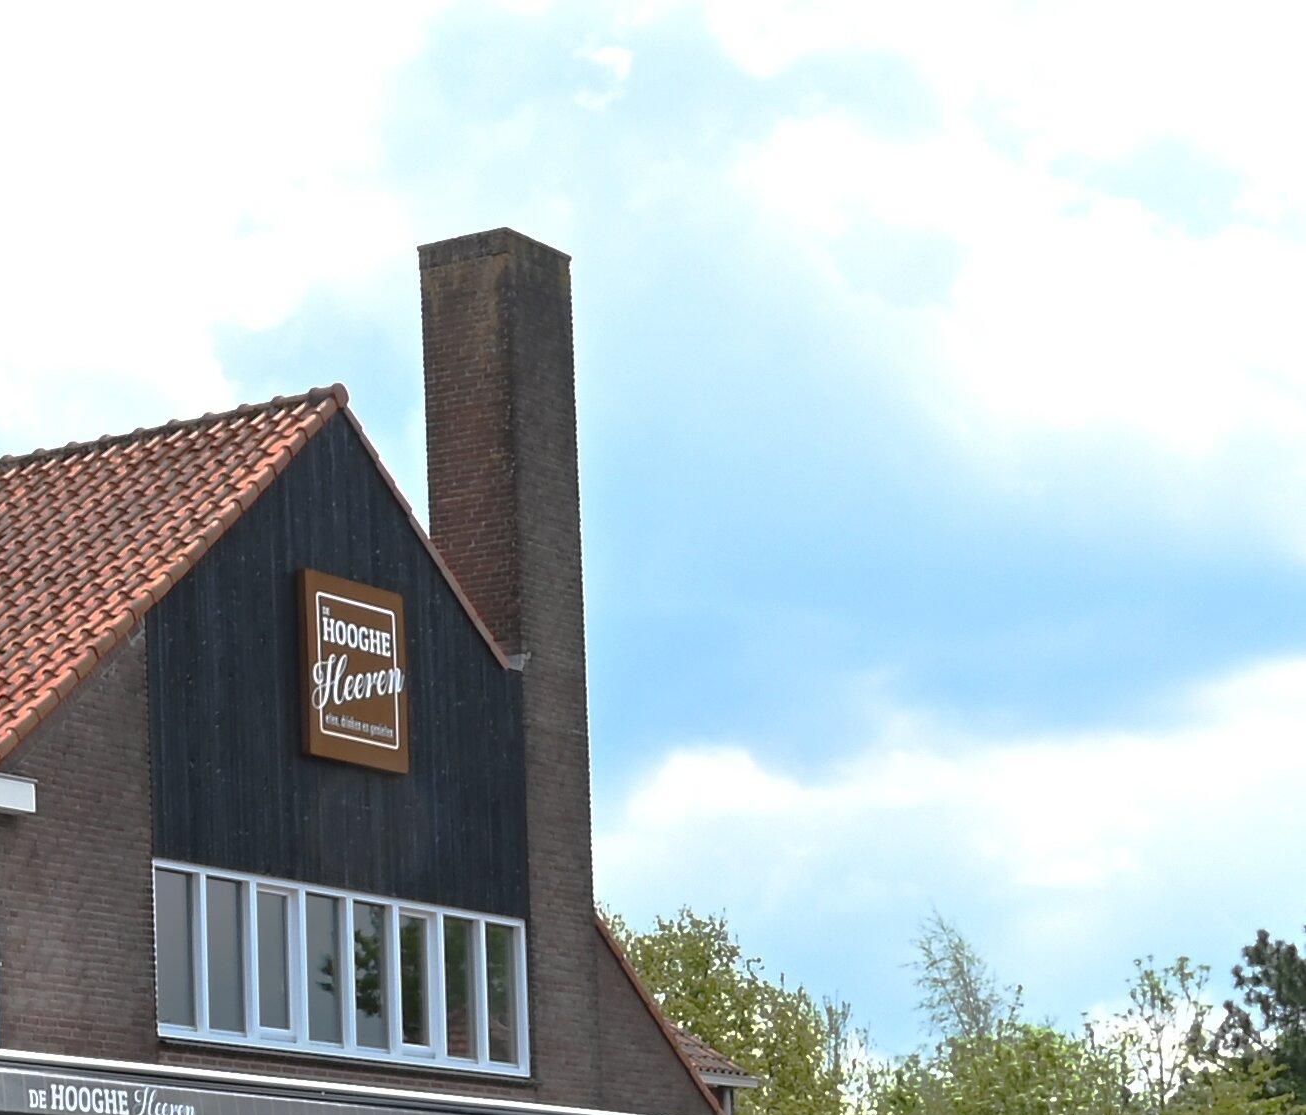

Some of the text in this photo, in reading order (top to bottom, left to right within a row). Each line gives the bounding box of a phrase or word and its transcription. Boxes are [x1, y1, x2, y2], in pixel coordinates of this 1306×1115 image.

[322, 616, 391, 657] HOOGHE
[312, 654, 405, 709] Heeren
[28, 1088, 47, 1109] DE
[50, 1084, 129, 1115] HOOGHE
